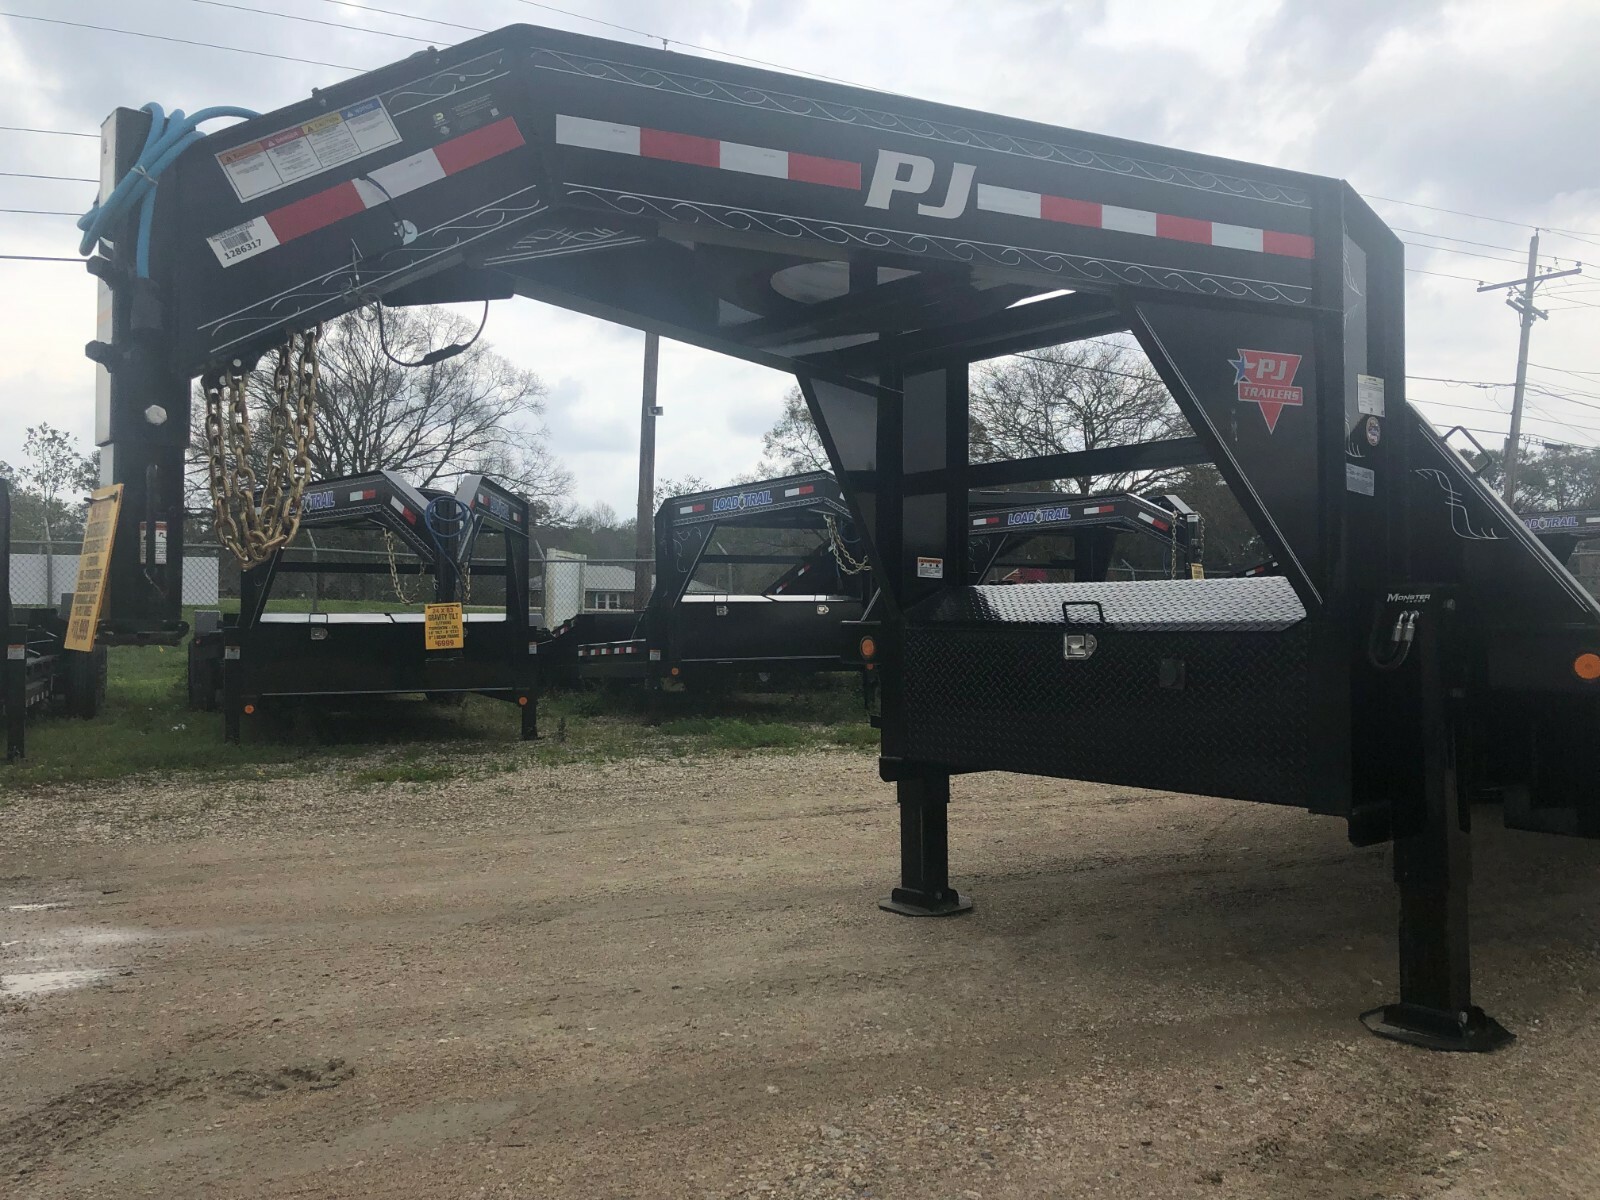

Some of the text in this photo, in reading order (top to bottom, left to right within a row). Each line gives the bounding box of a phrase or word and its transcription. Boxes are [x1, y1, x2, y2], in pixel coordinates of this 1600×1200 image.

[864, 149, 977, 219] PJ
[224, 238, 262, 260] 1286317
[1256, 358, 1288, 380] PJ
[1243, 386, 1300, 401] TRAILERS
[311, 490, 335, 509] TRAIL
[713, 490, 772, 512] LOAD TRAIL
[1008, 507, 1071, 525] LOAD TRAIL
[1545, 516, 1578, 528] TRAIL
[428, 613, 447, 621] GRAVITY
